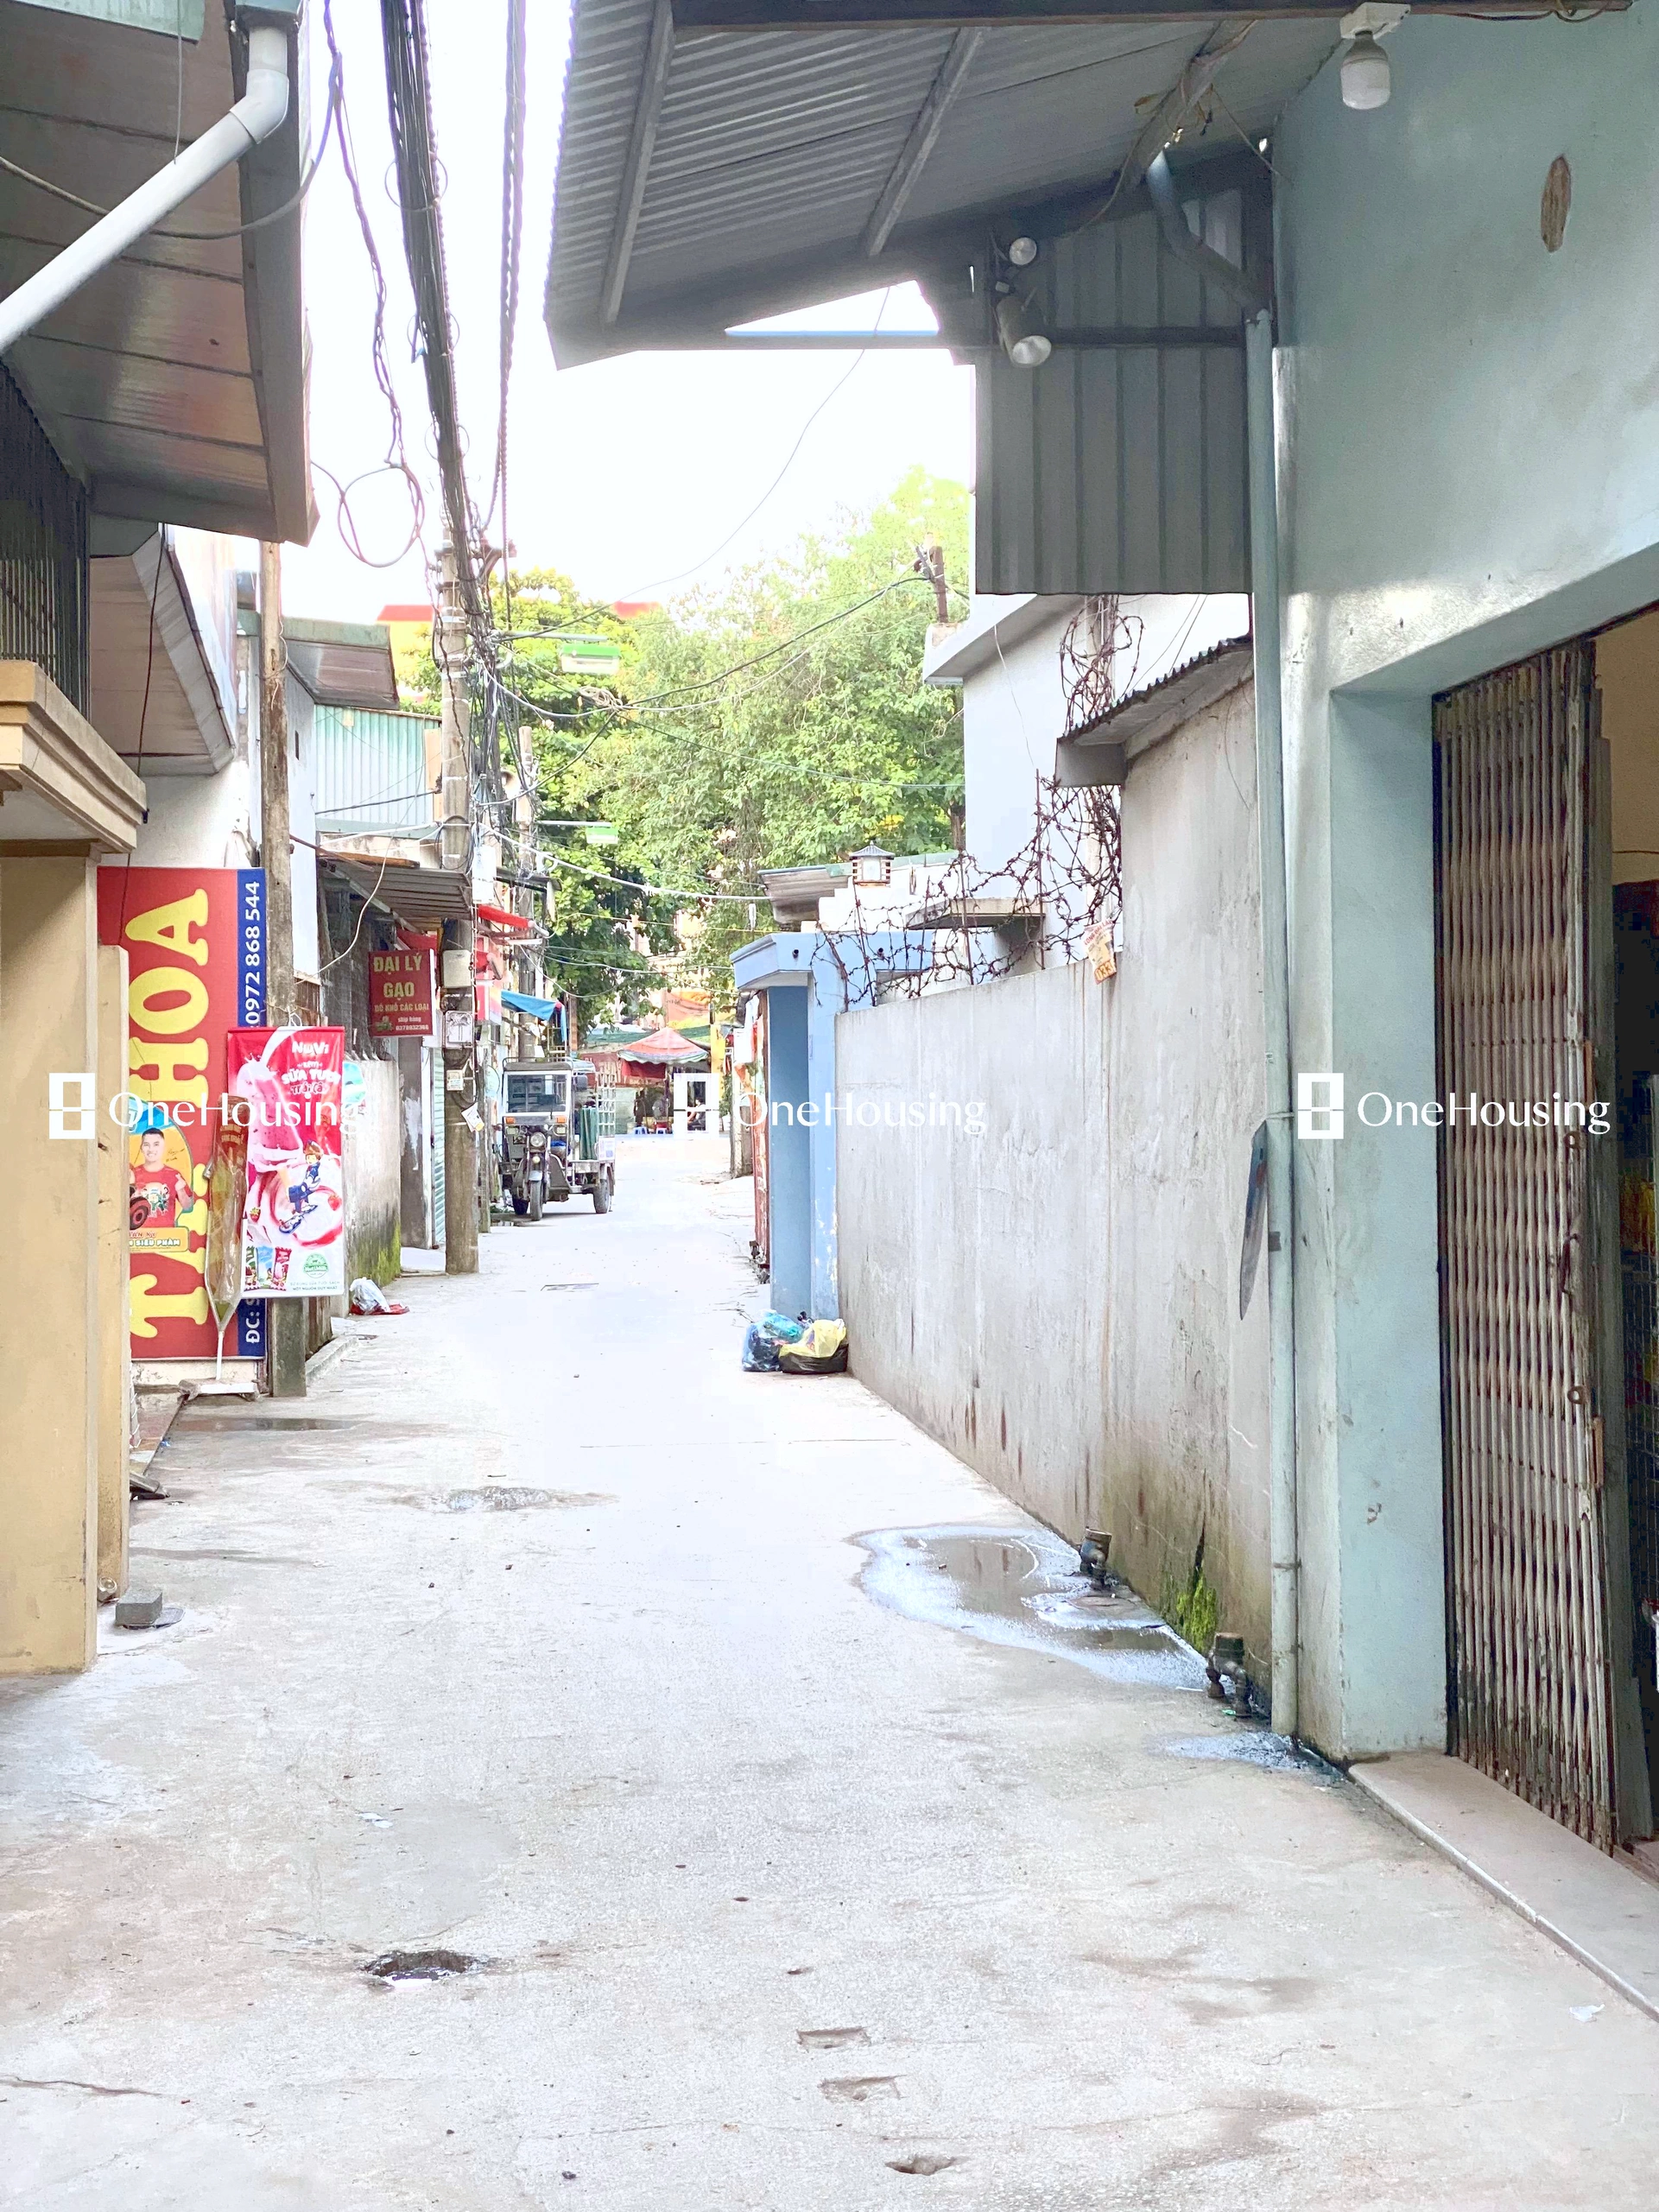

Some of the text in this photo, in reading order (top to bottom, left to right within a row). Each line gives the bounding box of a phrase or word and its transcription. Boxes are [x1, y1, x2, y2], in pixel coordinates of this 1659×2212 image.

[245, 881, 260, 1024] 0972 868 544
[373, 953, 422, 975] ĐẠI LÝ
[383, 981, 415, 1001] GẠO
